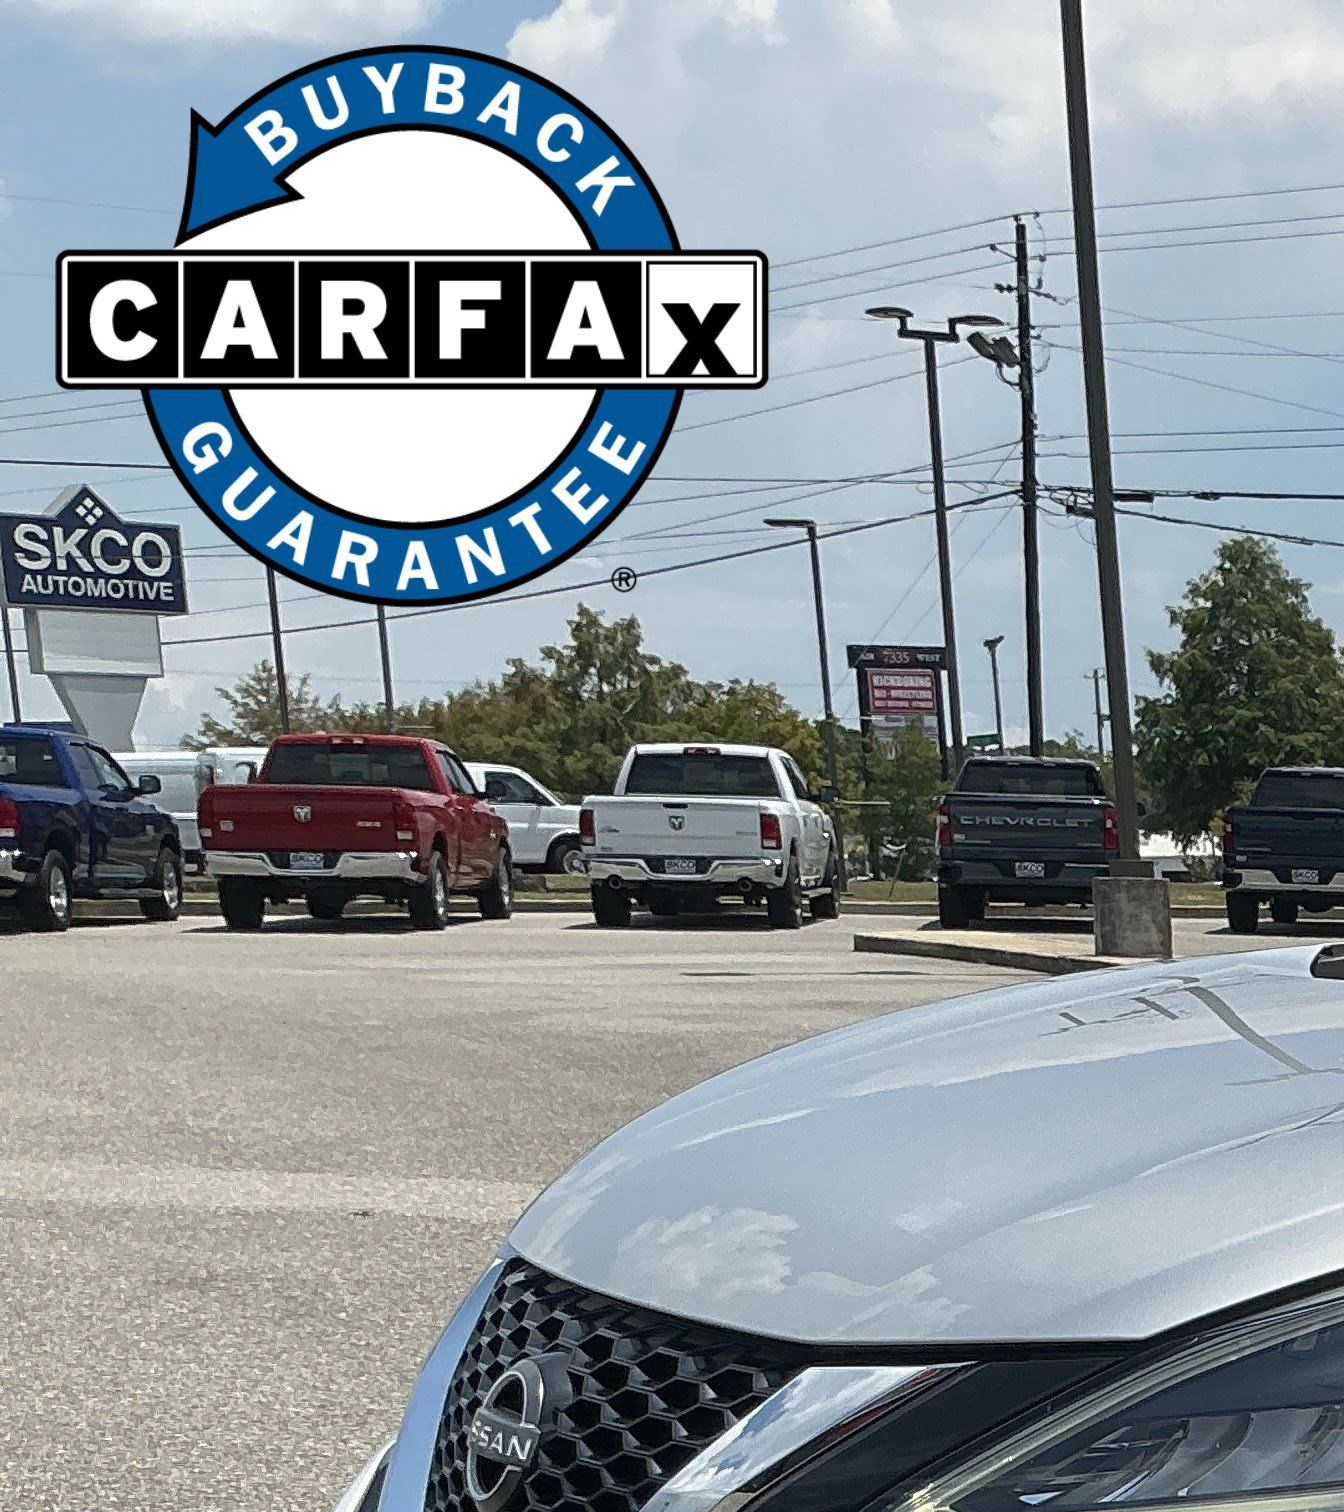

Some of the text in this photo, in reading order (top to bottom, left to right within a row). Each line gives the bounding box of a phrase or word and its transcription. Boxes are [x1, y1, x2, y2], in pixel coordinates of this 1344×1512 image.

[13, 523, 172, 577] SKCO
[21, 574, 174, 600] AUTOMOTIVE
[960, 815, 1093, 828] CHEVROLET
